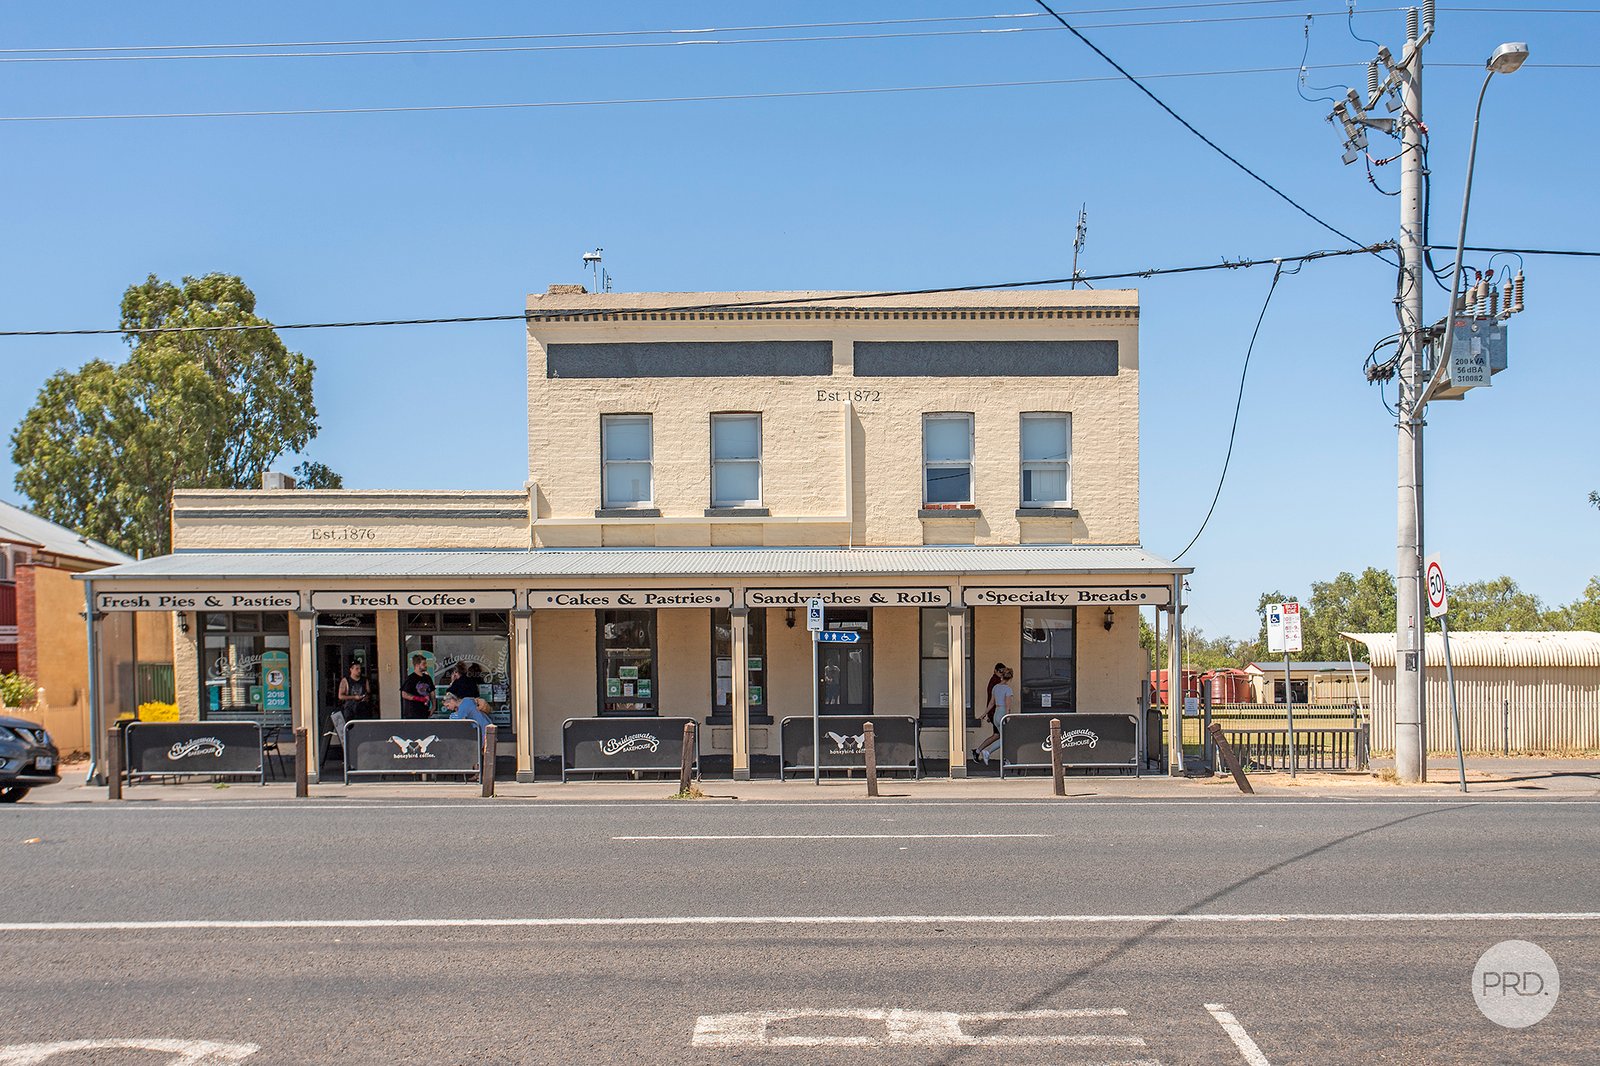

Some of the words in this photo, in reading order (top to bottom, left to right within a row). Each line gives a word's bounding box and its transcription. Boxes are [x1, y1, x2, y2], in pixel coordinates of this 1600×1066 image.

[1430, 574, 1442, 595] 50
[102, 595, 150, 608] Fresh
[158, 595, 195, 607] Pies
[204, 596, 223, 607] &
[232, 595, 292, 607] Pasties
[350, 594, 399, 606] Fresh
[408, 594, 467, 606] Coffee
[555, 593, 610, 605] Cakes
[617, 593, 637, 605] &
[644, 592, 713, 604] Pastries
[869, 592, 888, 603] &
[897, 591, 942, 603] Rolls
[985, 589, 1070, 605] Specialty
[1077, 589, 1138, 602] Breads
[812, 600, 819, 608] P
[1271, 605, 1278, 613] P
[603, 732, 660, 756] Bridgewater
[1041, 729, 1099, 751] idgewater
